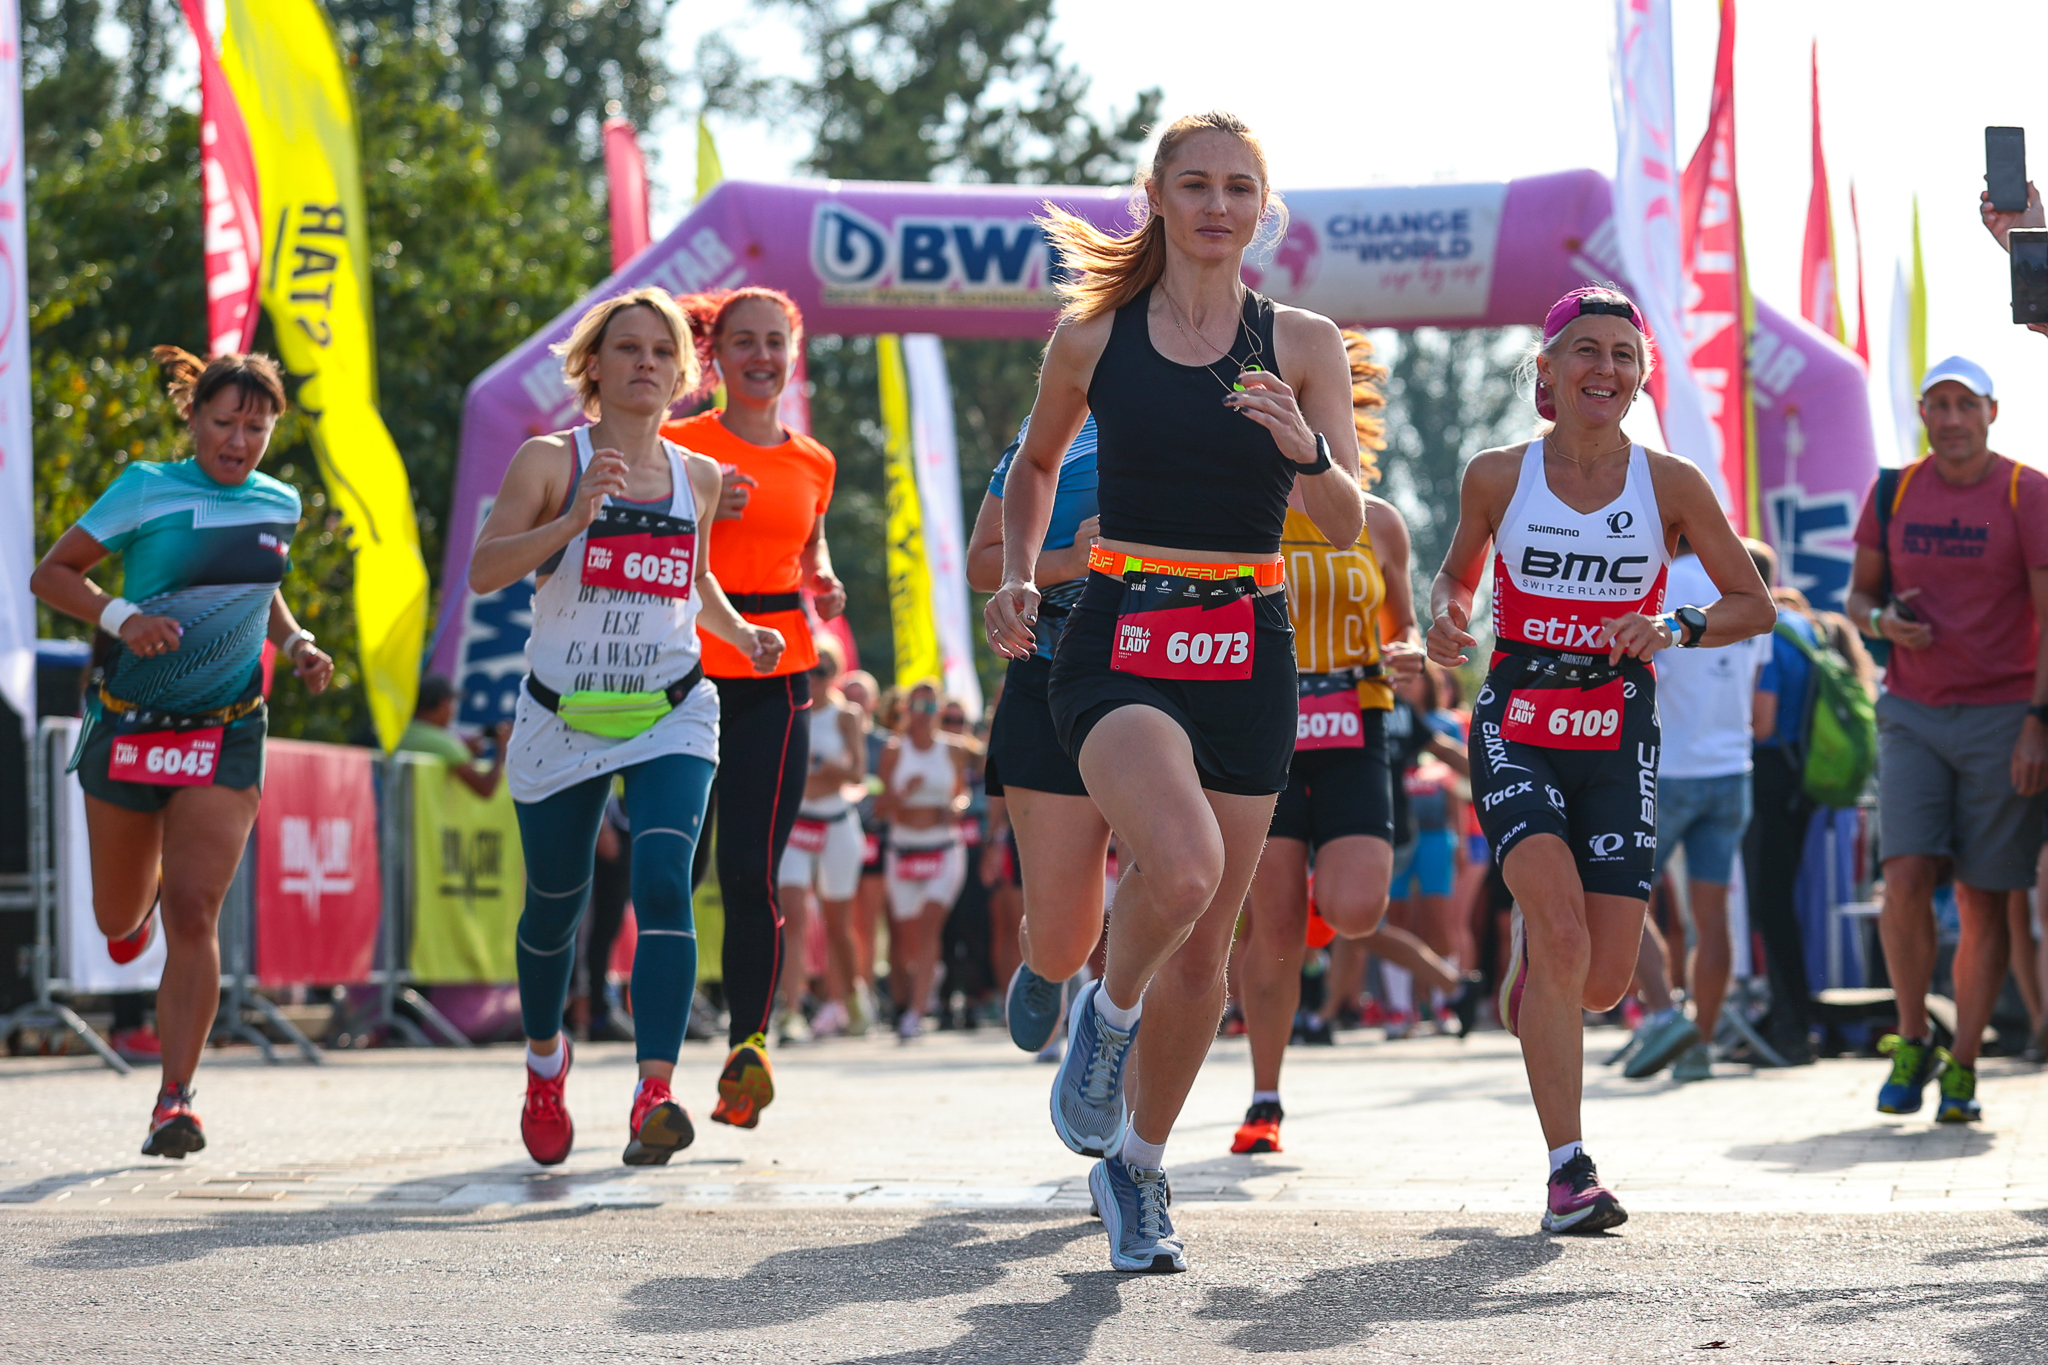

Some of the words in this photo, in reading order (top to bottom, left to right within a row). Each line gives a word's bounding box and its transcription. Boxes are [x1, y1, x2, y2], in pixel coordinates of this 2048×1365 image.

[1326, 209, 1470, 237] CHANGE
[1359, 237, 1472, 263] WORLD
[1527, 523, 1580, 538] SHIMANO
[587, 554, 612, 570] LADY
[623, 552, 689, 588] 6033
[1143, 563, 1239, 580] POWERUP
[1521, 546, 1649, 583] BMC
[579, 585, 600, 604] BE
[1130, 583, 1147, 592] STAR
[1522, 578, 1628, 597] SWITZERLAND
[602, 610, 645, 636] ELSE
[1121, 624, 1143, 638] IRON
[565, 640, 584, 666] IS
[587, 641, 600, 667] A
[607, 641, 664, 668] WASTE
[1118, 637, 1150, 653] LADY
[1166, 631, 1249, 665] 6073
[1560, 652, 1594, 666] IRONSTAR
[574, 673, 594, 692] OF
[603, 673, 645, 693] WHO
[1512, 697, 1531, 711] IRON
[1298, 711, 1359, 740] 6070
[1508, 706, 1536, 725] LADY
[1548, 707, 1619, 738] 6109
[146, 746, 214, 777] 6045
[1637, 741, 1656, 827] BMC
[1481, 780, 1534, 812] Tacx
[1633, 831, 1657, 848] Tac
